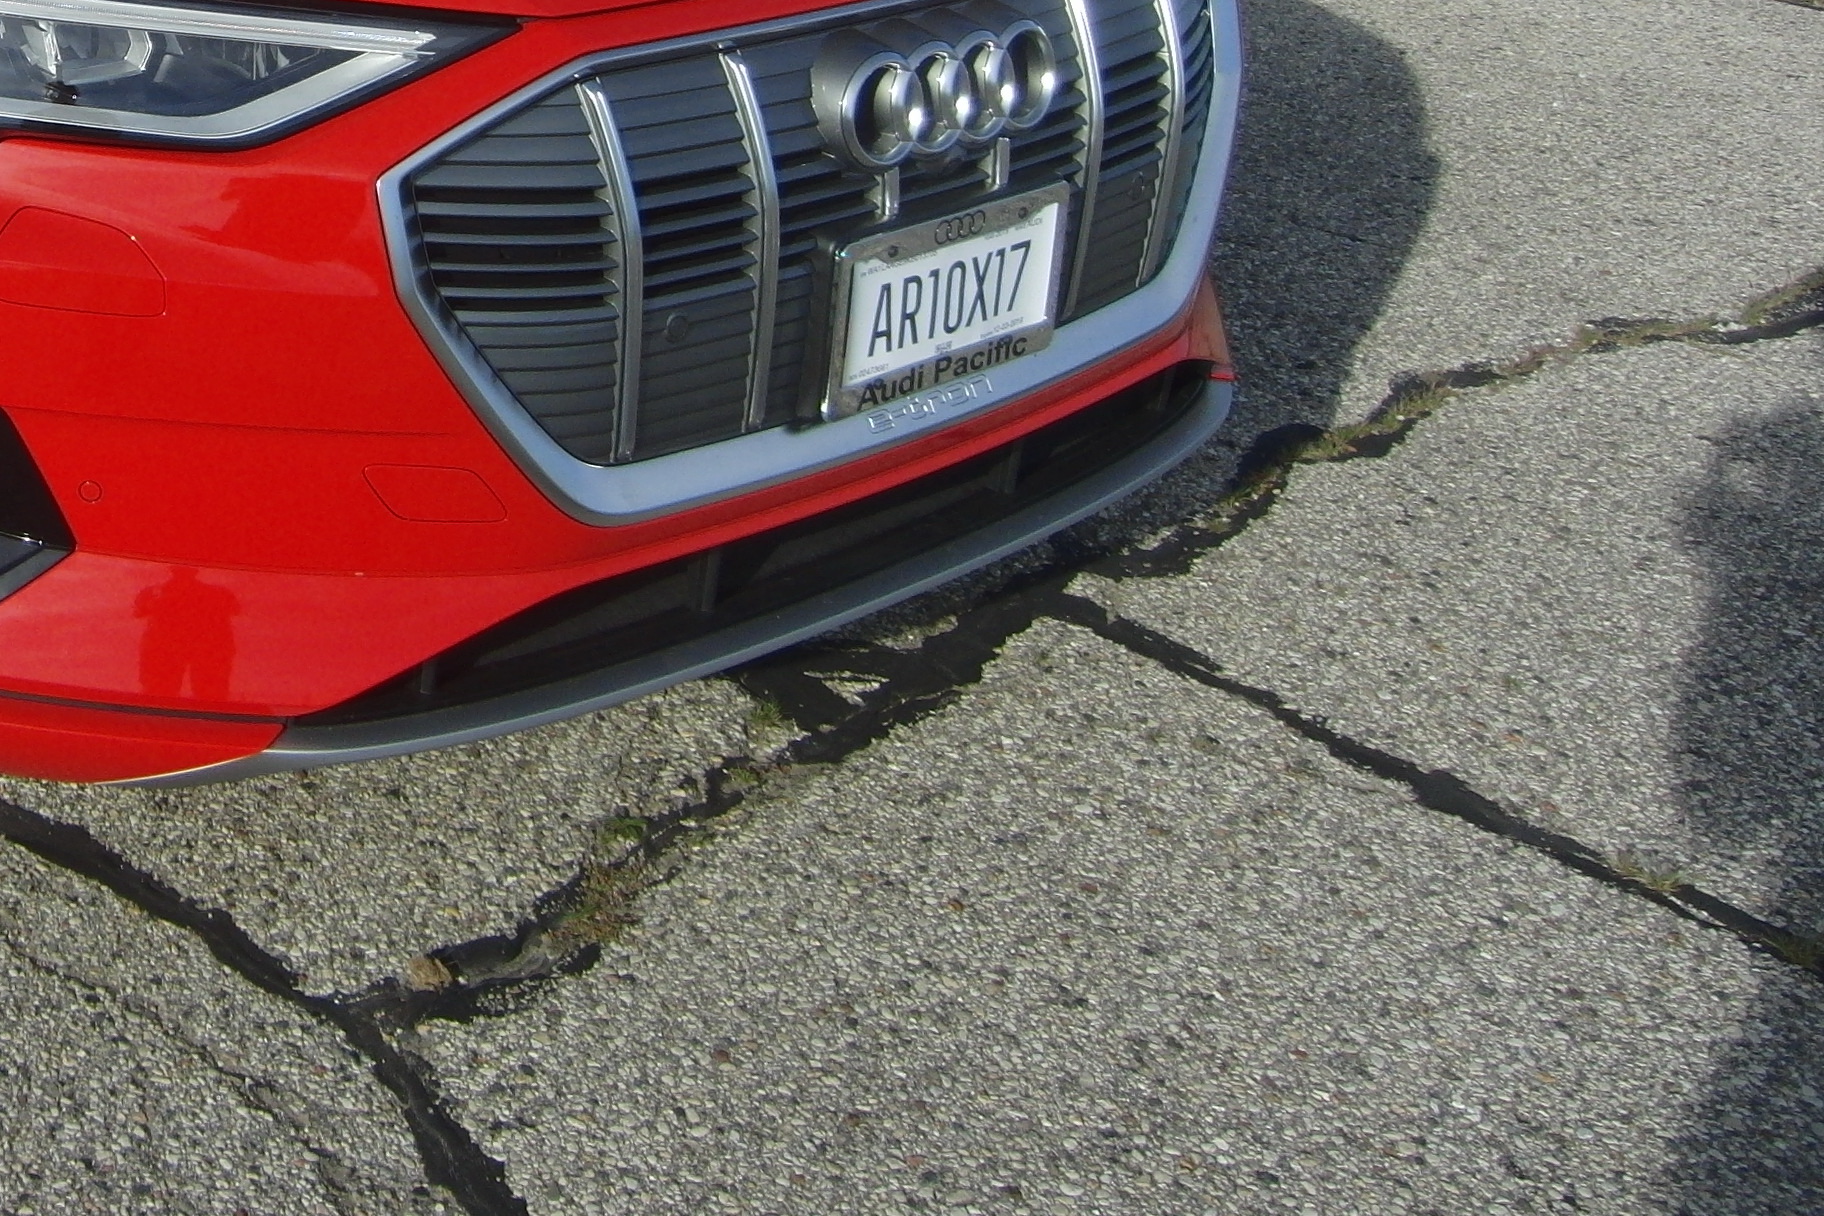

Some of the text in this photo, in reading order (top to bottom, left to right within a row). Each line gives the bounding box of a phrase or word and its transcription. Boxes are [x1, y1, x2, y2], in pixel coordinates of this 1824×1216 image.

[867, 239, 1031, 358] AR10X17
[857, 335, 1029, 411] Audi Pacific
[867, 373, 994, 435] e-tron
